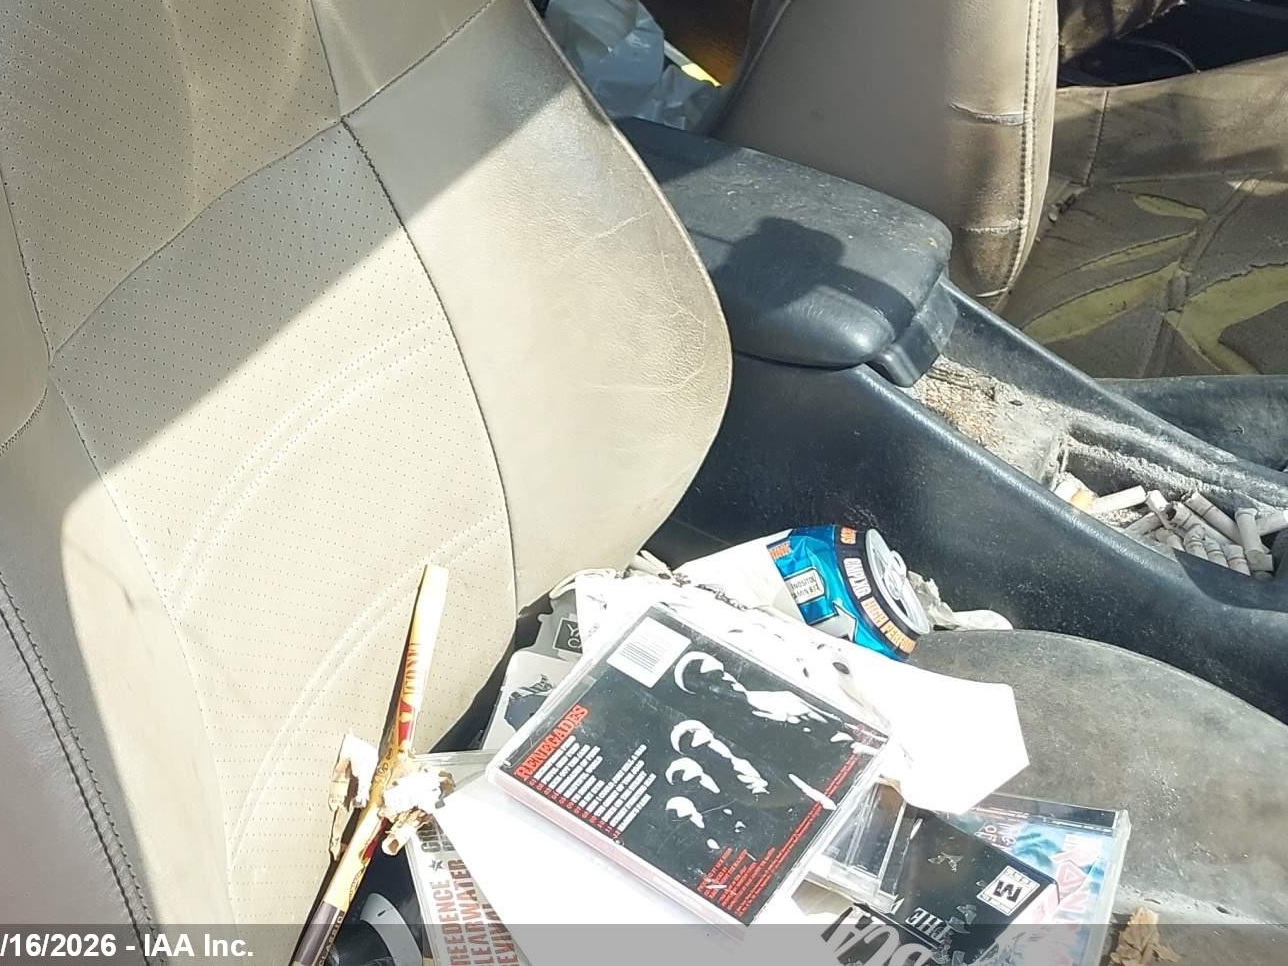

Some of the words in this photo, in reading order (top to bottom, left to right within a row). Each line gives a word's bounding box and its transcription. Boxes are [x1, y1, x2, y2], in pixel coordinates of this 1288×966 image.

[513, 704, 589, 781] RENEGADES
[429, 880, 472, 966] REEDENCE
[447, 859, 495, 966] LEARWATER
[905, 906, 954, 944] THE
